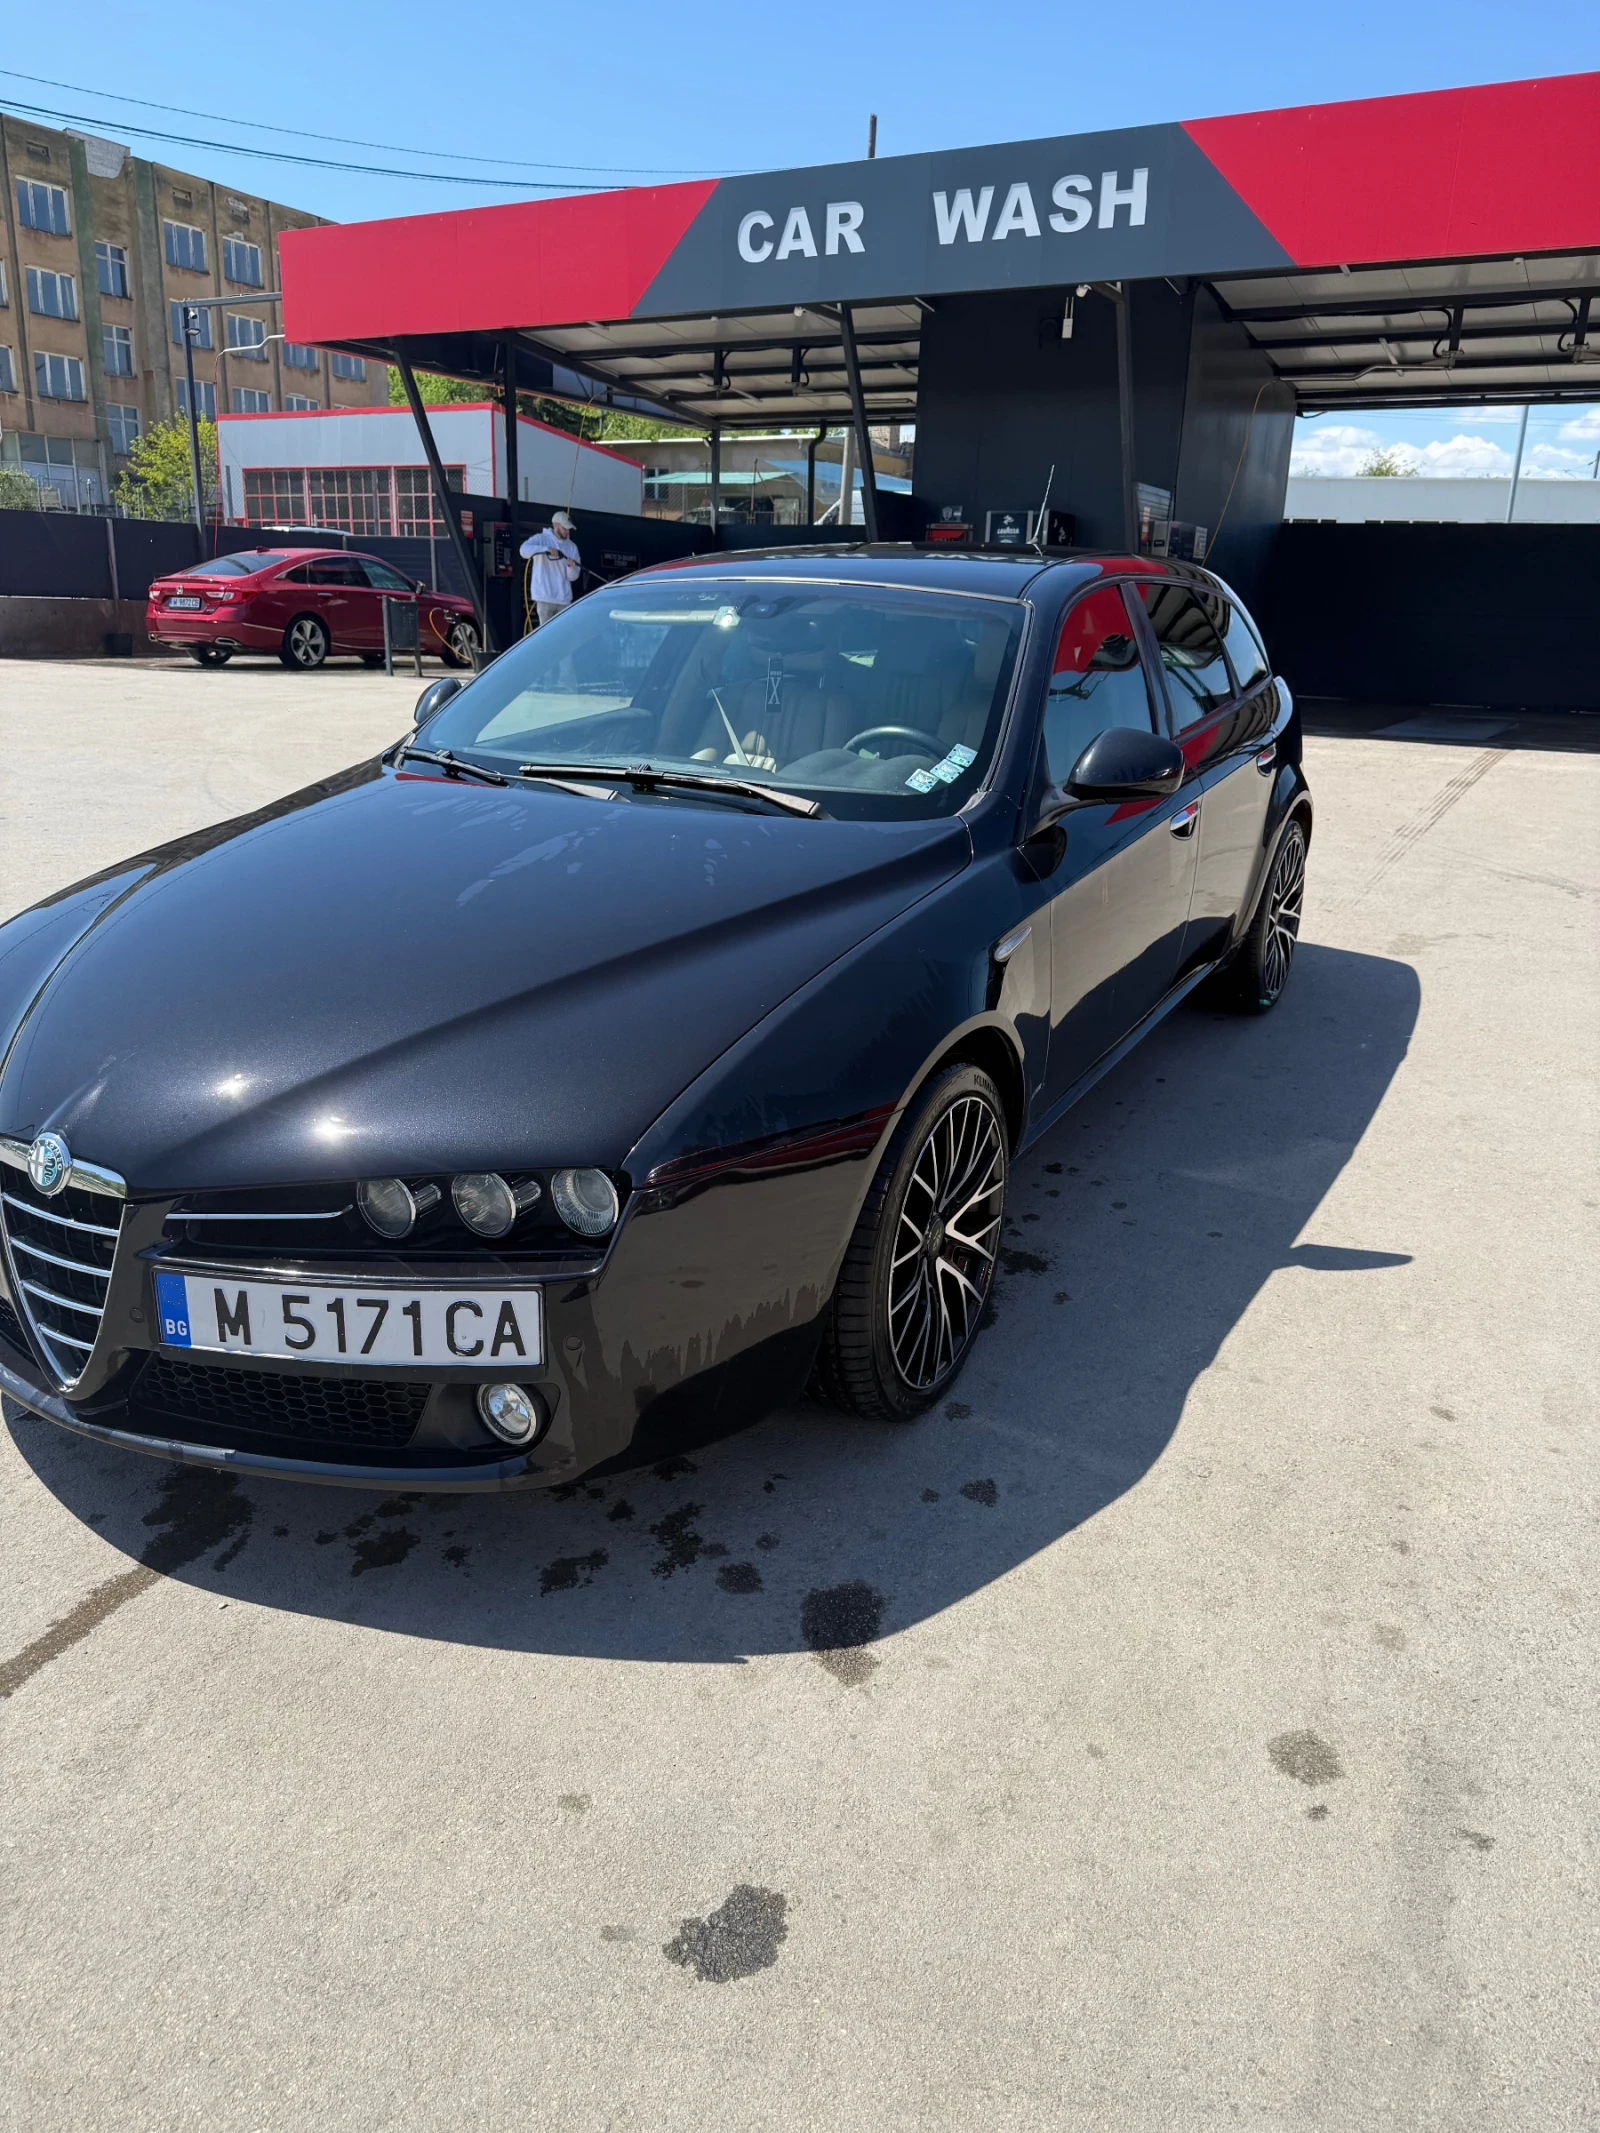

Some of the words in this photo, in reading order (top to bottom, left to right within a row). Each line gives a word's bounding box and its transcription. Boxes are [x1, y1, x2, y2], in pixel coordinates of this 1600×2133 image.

[737, 201, 866, 263] CAR
[932, 168, 1149, 245] WASH
[165, 1318, 188, 1336] BG
[213, 1288, 252, 1346] M
